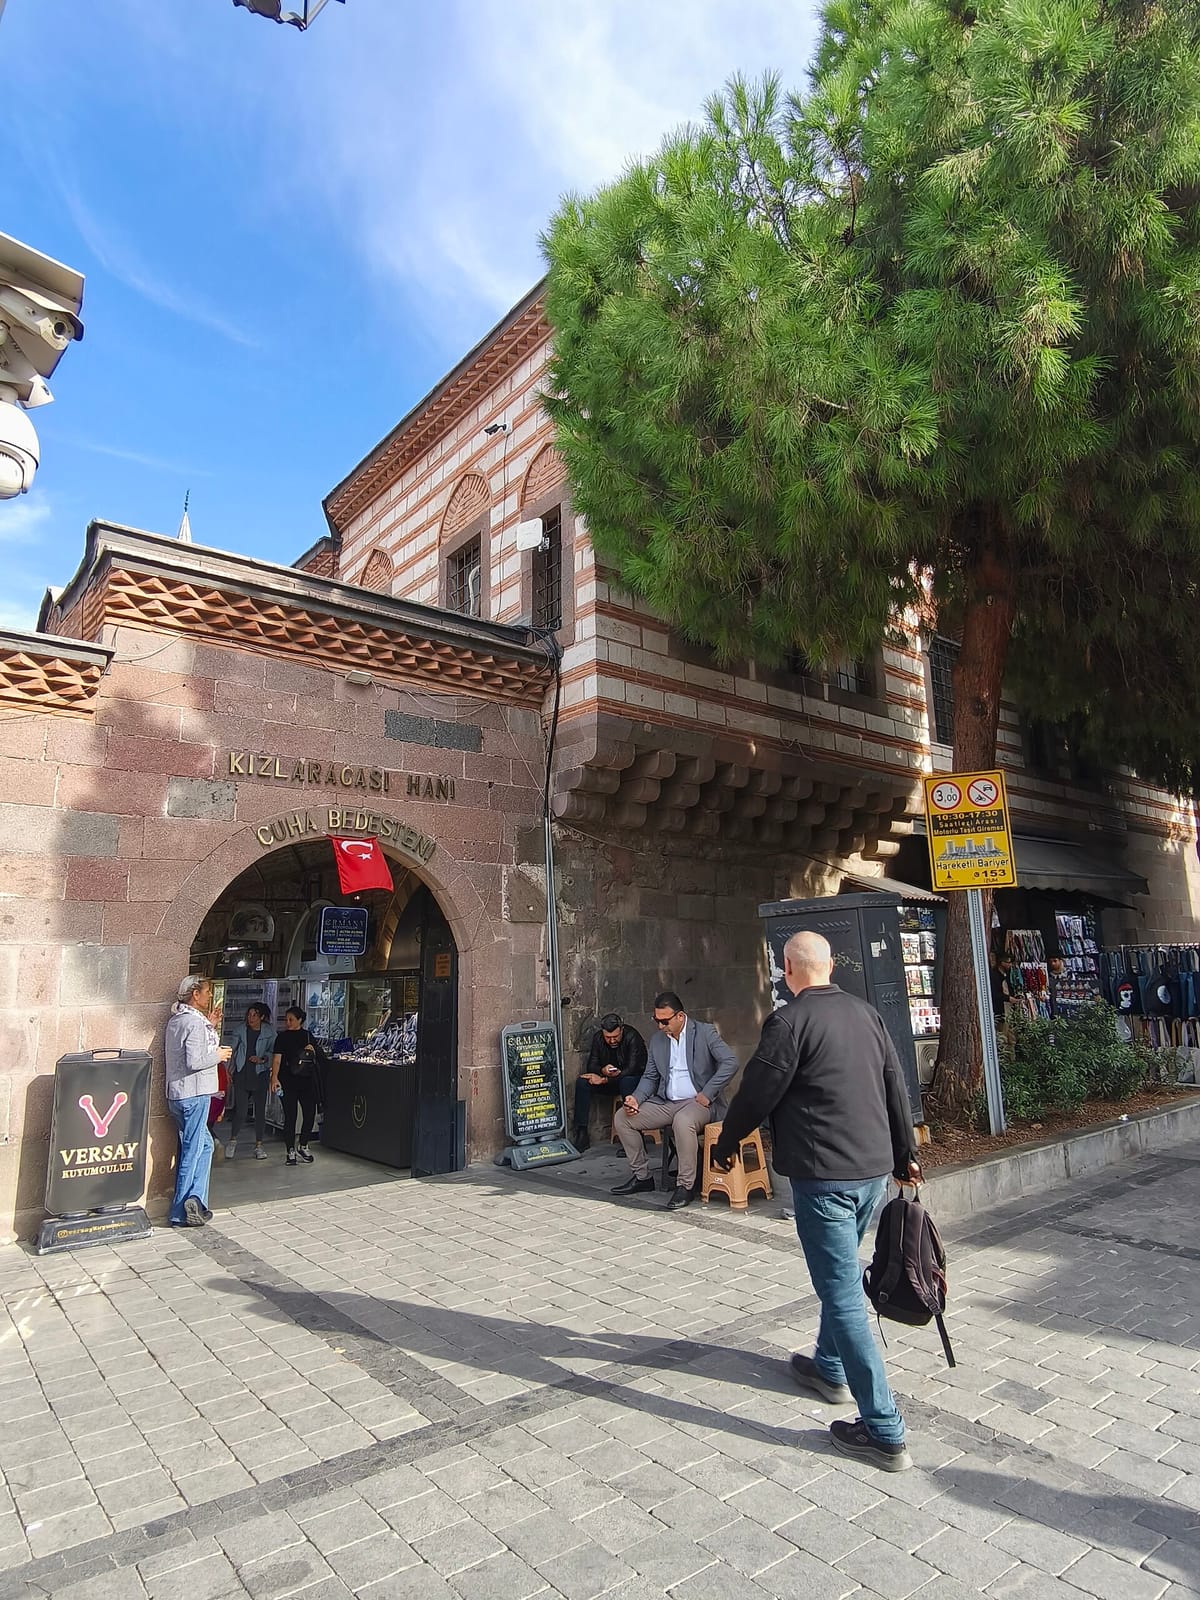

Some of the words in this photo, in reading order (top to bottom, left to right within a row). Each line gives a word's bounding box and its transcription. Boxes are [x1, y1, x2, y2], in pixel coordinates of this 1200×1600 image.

[406, 775, 456, 800] HANI
[936, 810, 998, 821] 10:30-17:30
[936, 860, 975, 870] Hareketli
[978, 858, 1008, 869] Bariyer
[982, 869, 1006, 878] 153
[60, 1142, 139, 1166] VERSAY
[61, 1163, 134, 1179] KUYUMCULUK
